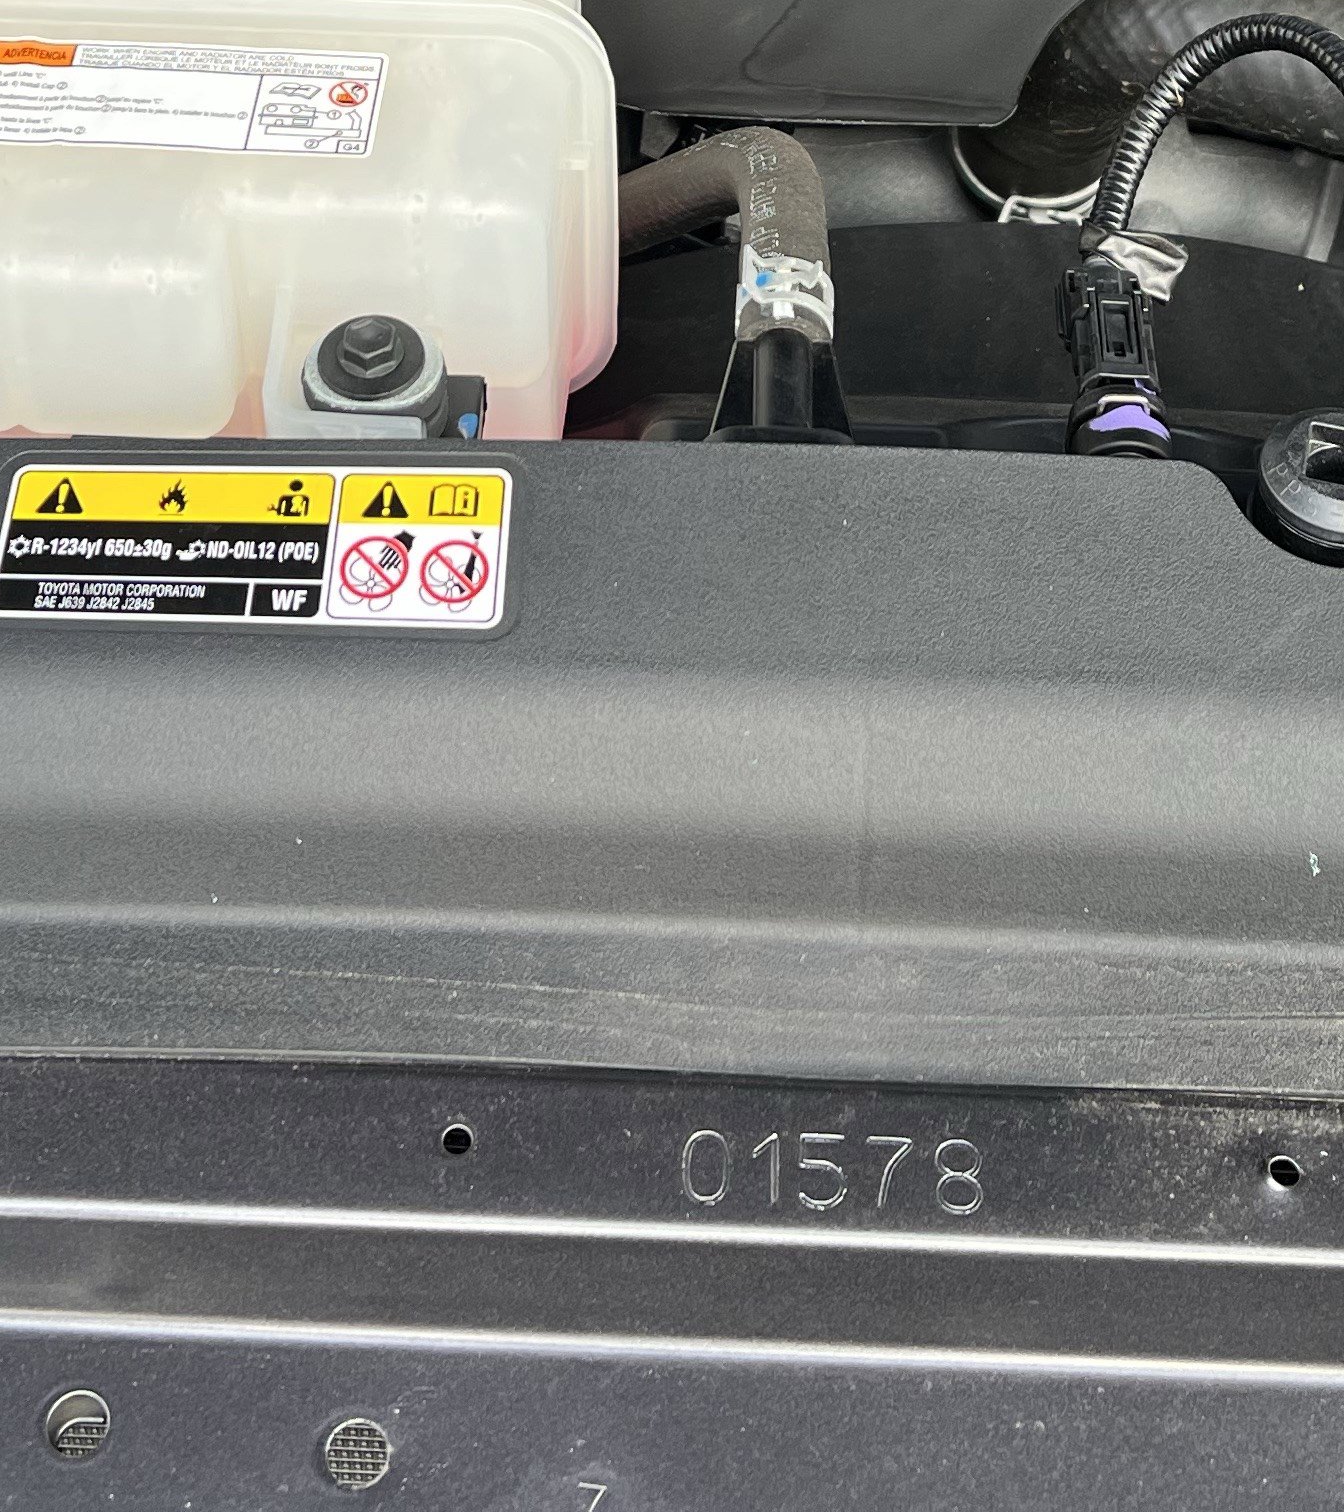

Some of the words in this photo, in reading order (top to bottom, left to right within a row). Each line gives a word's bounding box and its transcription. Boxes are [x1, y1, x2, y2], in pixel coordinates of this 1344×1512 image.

[3, 47, 67, 61] ADVERTENCIA
[342, 142, 361, 152] G4
[30, 537, 102, 560] R-1234yf
[104, 538, 173, 561] 650±30g
[206, 539, 276, 561] ND-OIL12
[278, 540, 320, 565] (POE)
[37, 581, 81, 596] TOYOTA
[82, 583, 123, 597] MOTOR
[125, 583, 206, 599] CORPORATION
[34, 595, 56, 609] SAE
[58, 596, 85, 610] J639
[86, 596, 120, 611] J2842
[120, 597, 156, 611] J2845
[271, 589, 308, 611] WF
[682, 1129, 984, 1215] 01578
